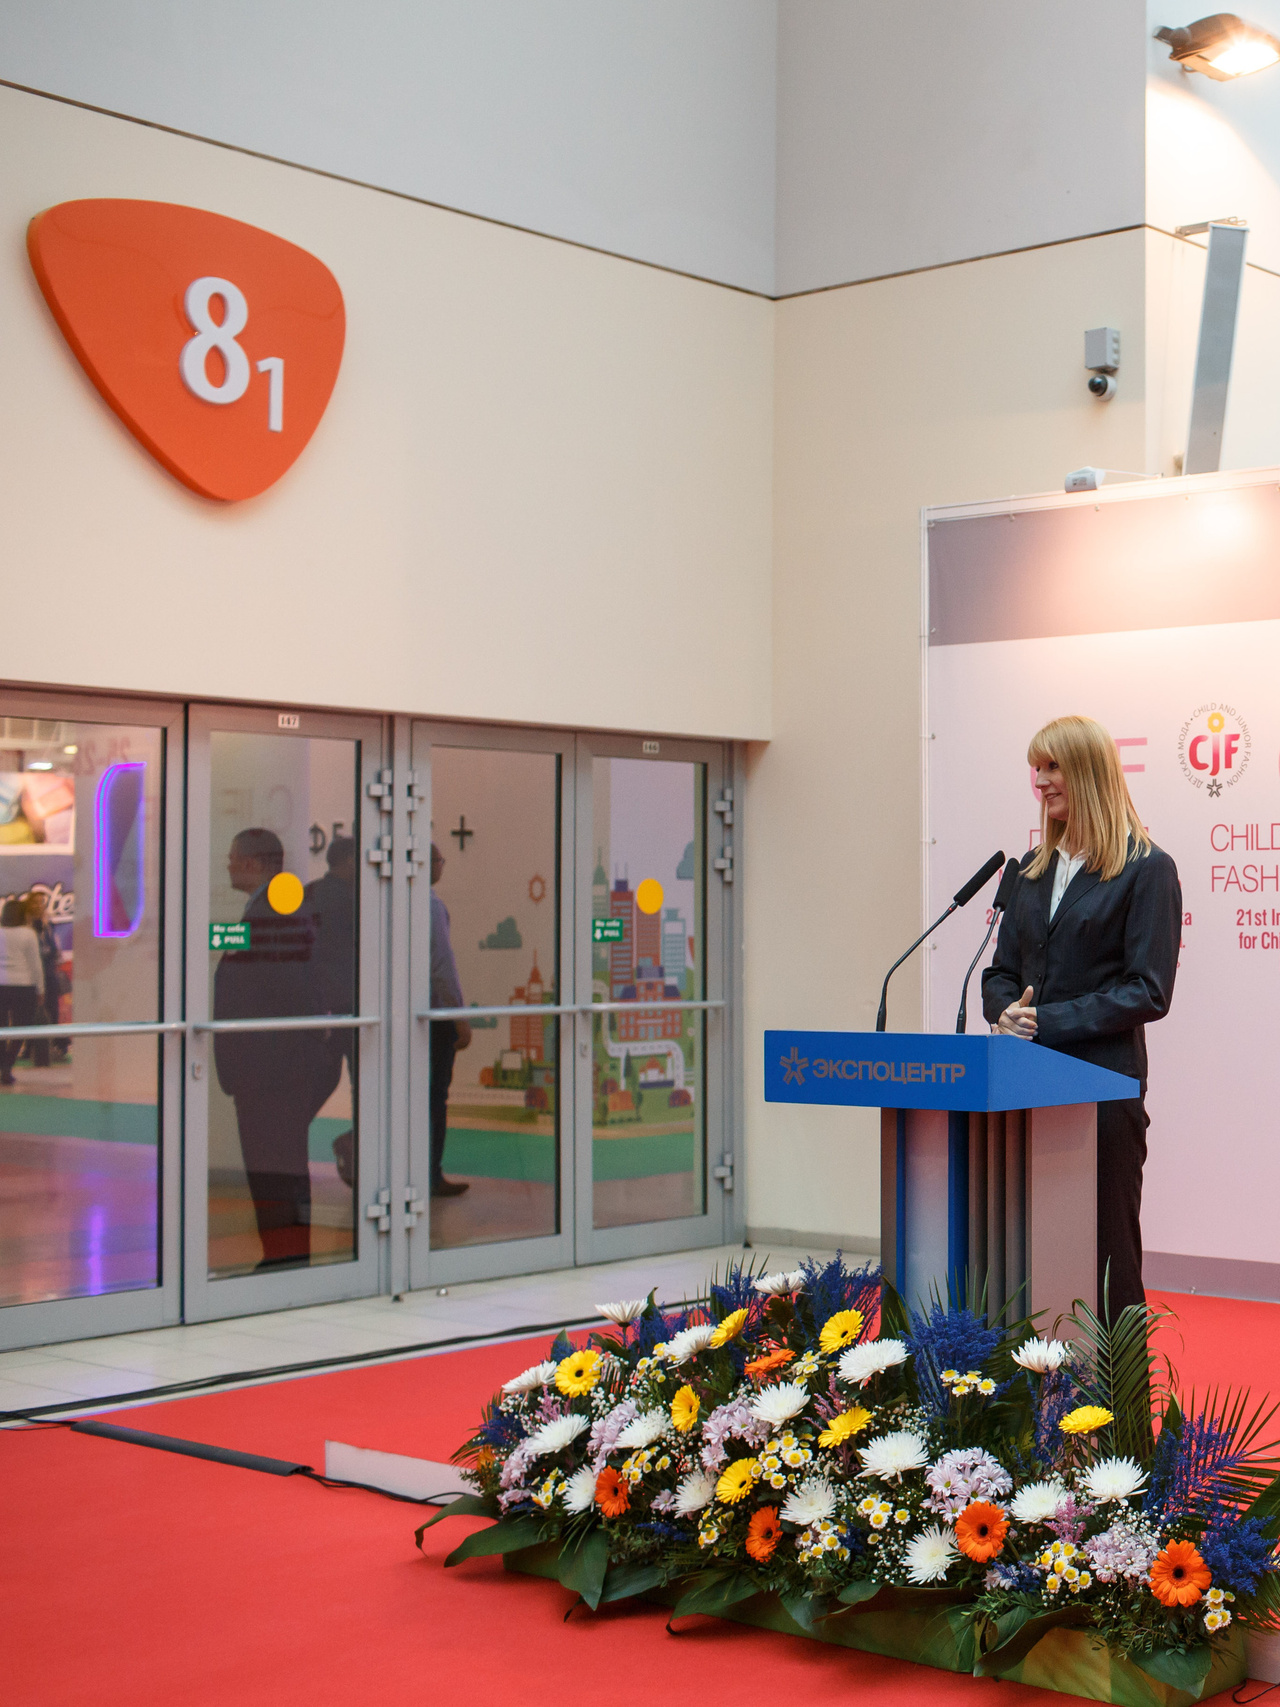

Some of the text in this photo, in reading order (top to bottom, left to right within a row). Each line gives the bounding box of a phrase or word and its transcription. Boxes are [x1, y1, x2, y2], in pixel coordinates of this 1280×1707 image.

[1193, 702, 1251, 788] CHILD AND JUNIOR FASHION
[1236, 908, 1267, 926] 21st
[1238, 932, 1257, 949] for
[812, 1058, 966, 1085] ЭКСПОЦЕНТР
